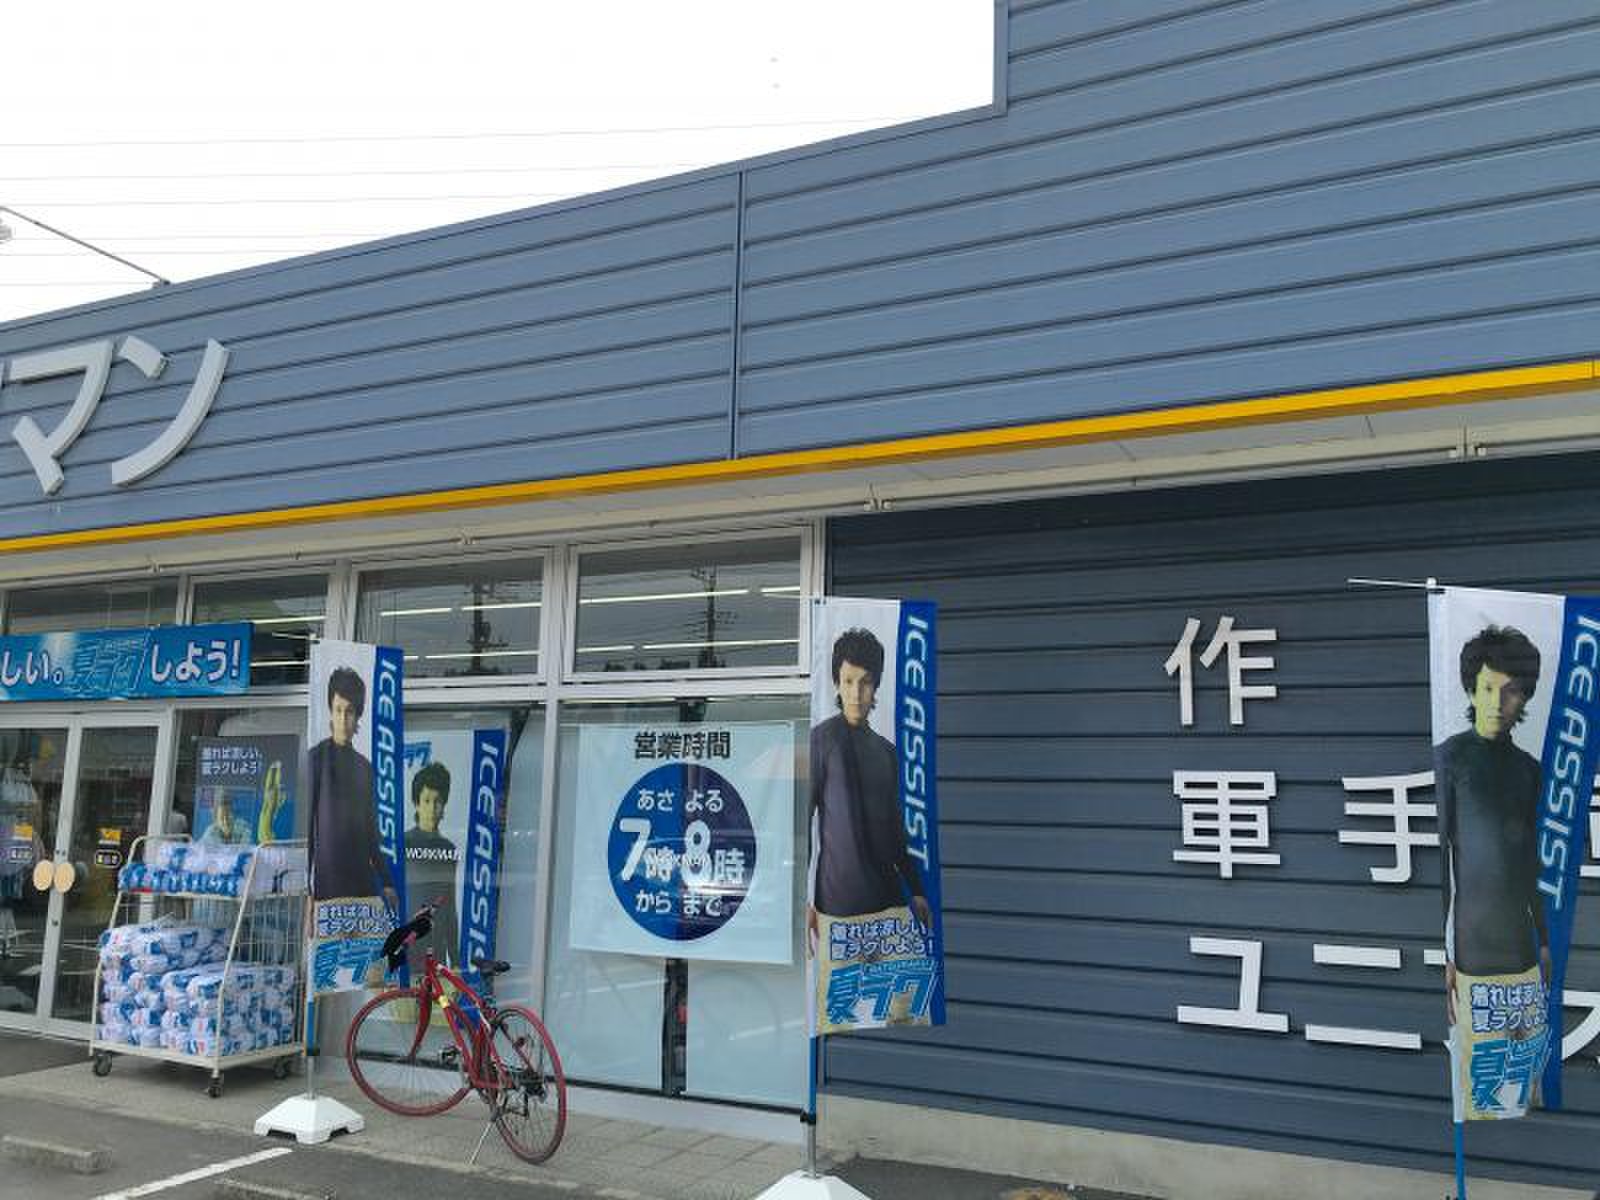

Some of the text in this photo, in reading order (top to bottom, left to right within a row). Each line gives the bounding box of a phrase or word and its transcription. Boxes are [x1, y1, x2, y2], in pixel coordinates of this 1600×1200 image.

[0, 335, 230, 495] マン
[634, 732, 731, 759] 営業時間
[903, 614, 930, 871] ICE ASSIST
[1164, 616, 1277, 725] 作
[377, 658, 398, 864] ICE ASSIST
[637, 788, 724, 813] あさ よる
[1538, 615, 1600, 911] ICE ASSIST
[467, 742, 499, 974] ICE ASSIS
[635, 889, 672, 914] から
